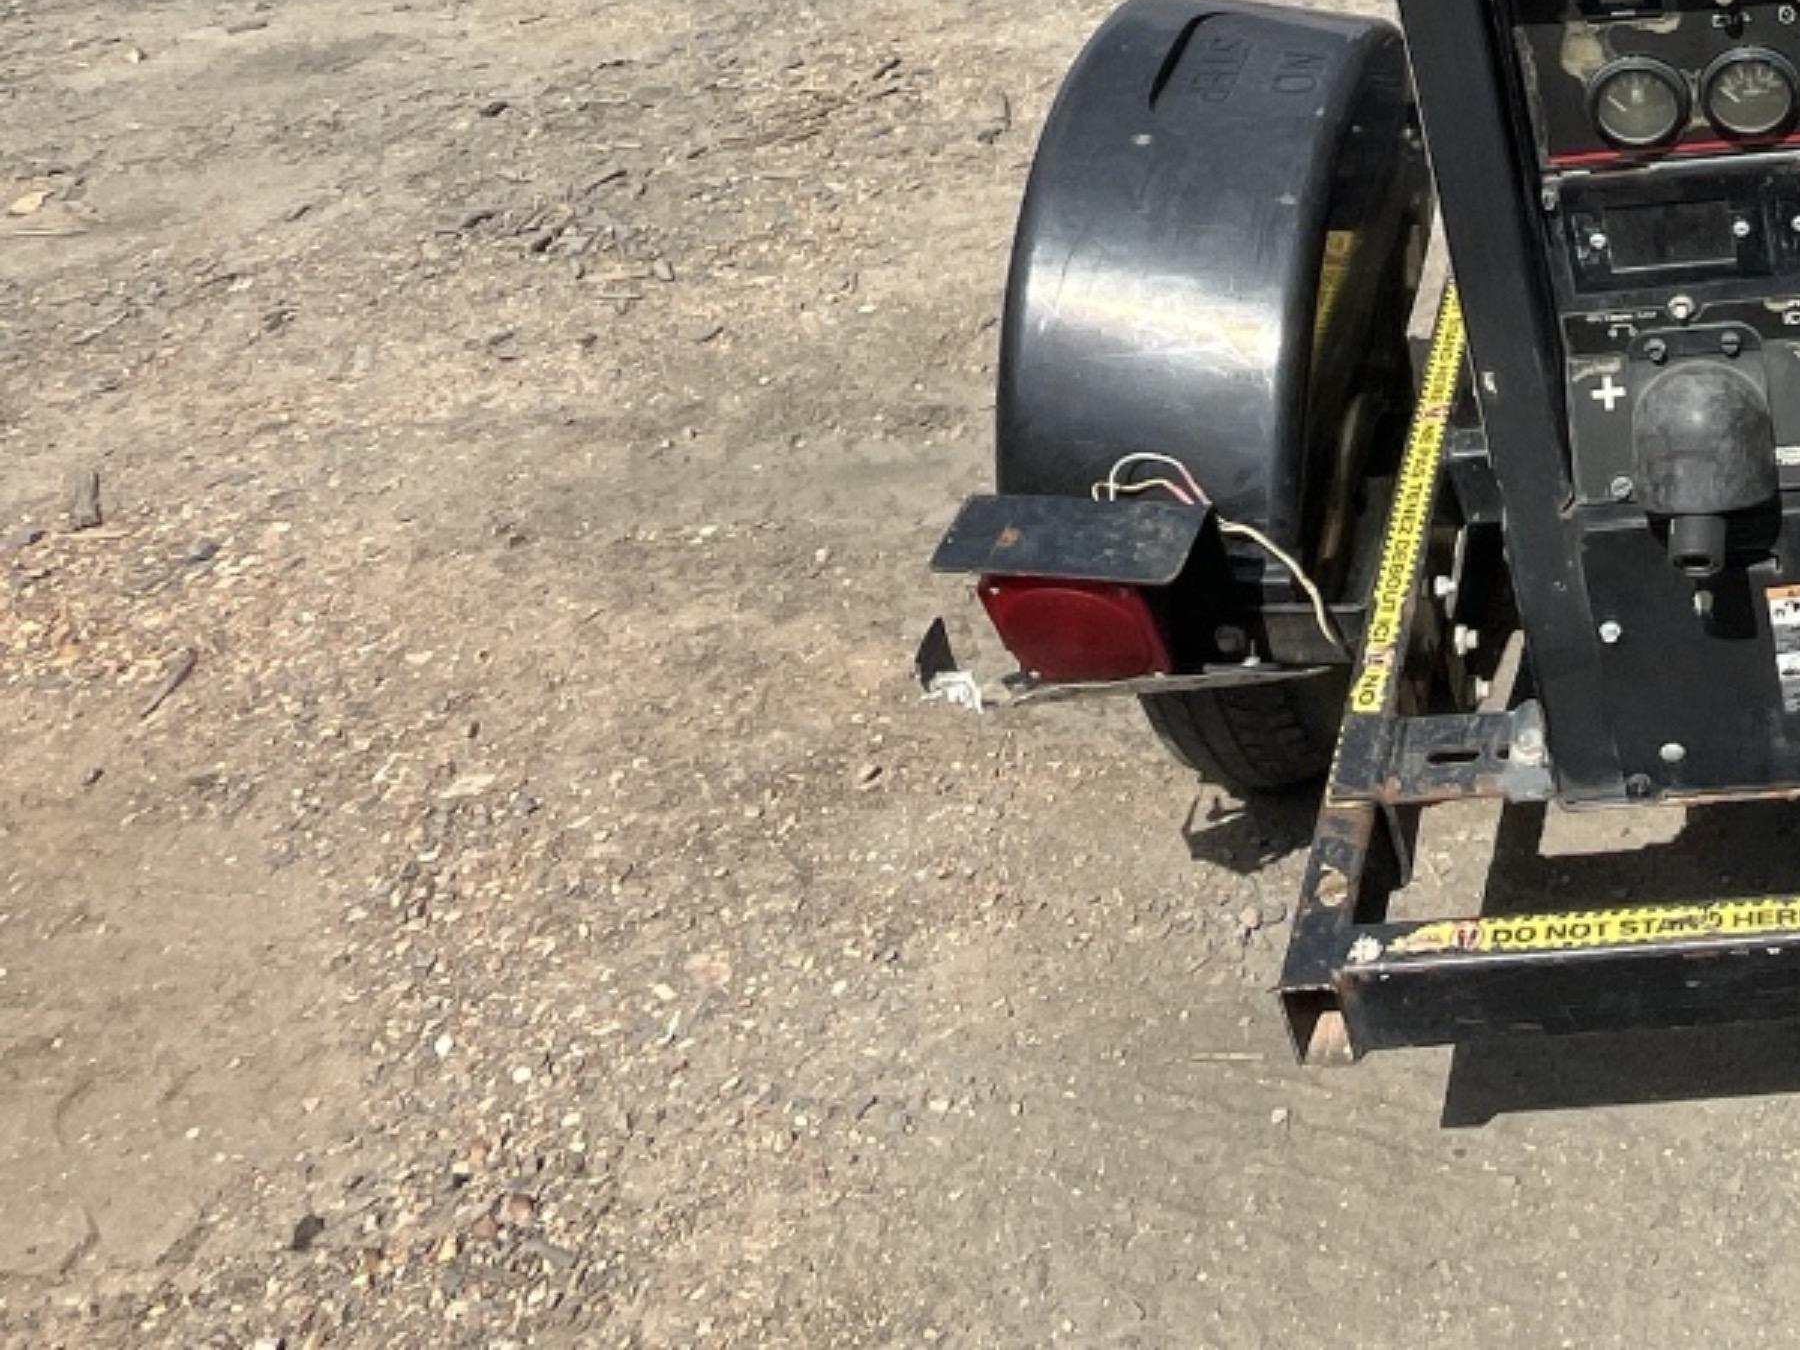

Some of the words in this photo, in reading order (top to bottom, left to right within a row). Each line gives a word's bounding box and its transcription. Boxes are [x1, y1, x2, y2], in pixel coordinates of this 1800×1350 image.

[1398, 483, 1423, 536] TENEZ
[1380, 539, 1411, 614] DEBOUT
[1372, 619, 1390, 643] ICI
[1358, 674, 1379, 706] NO
[1491, 924, 1540, 944] DO
[1545, 920, 1608, 942] NOT
